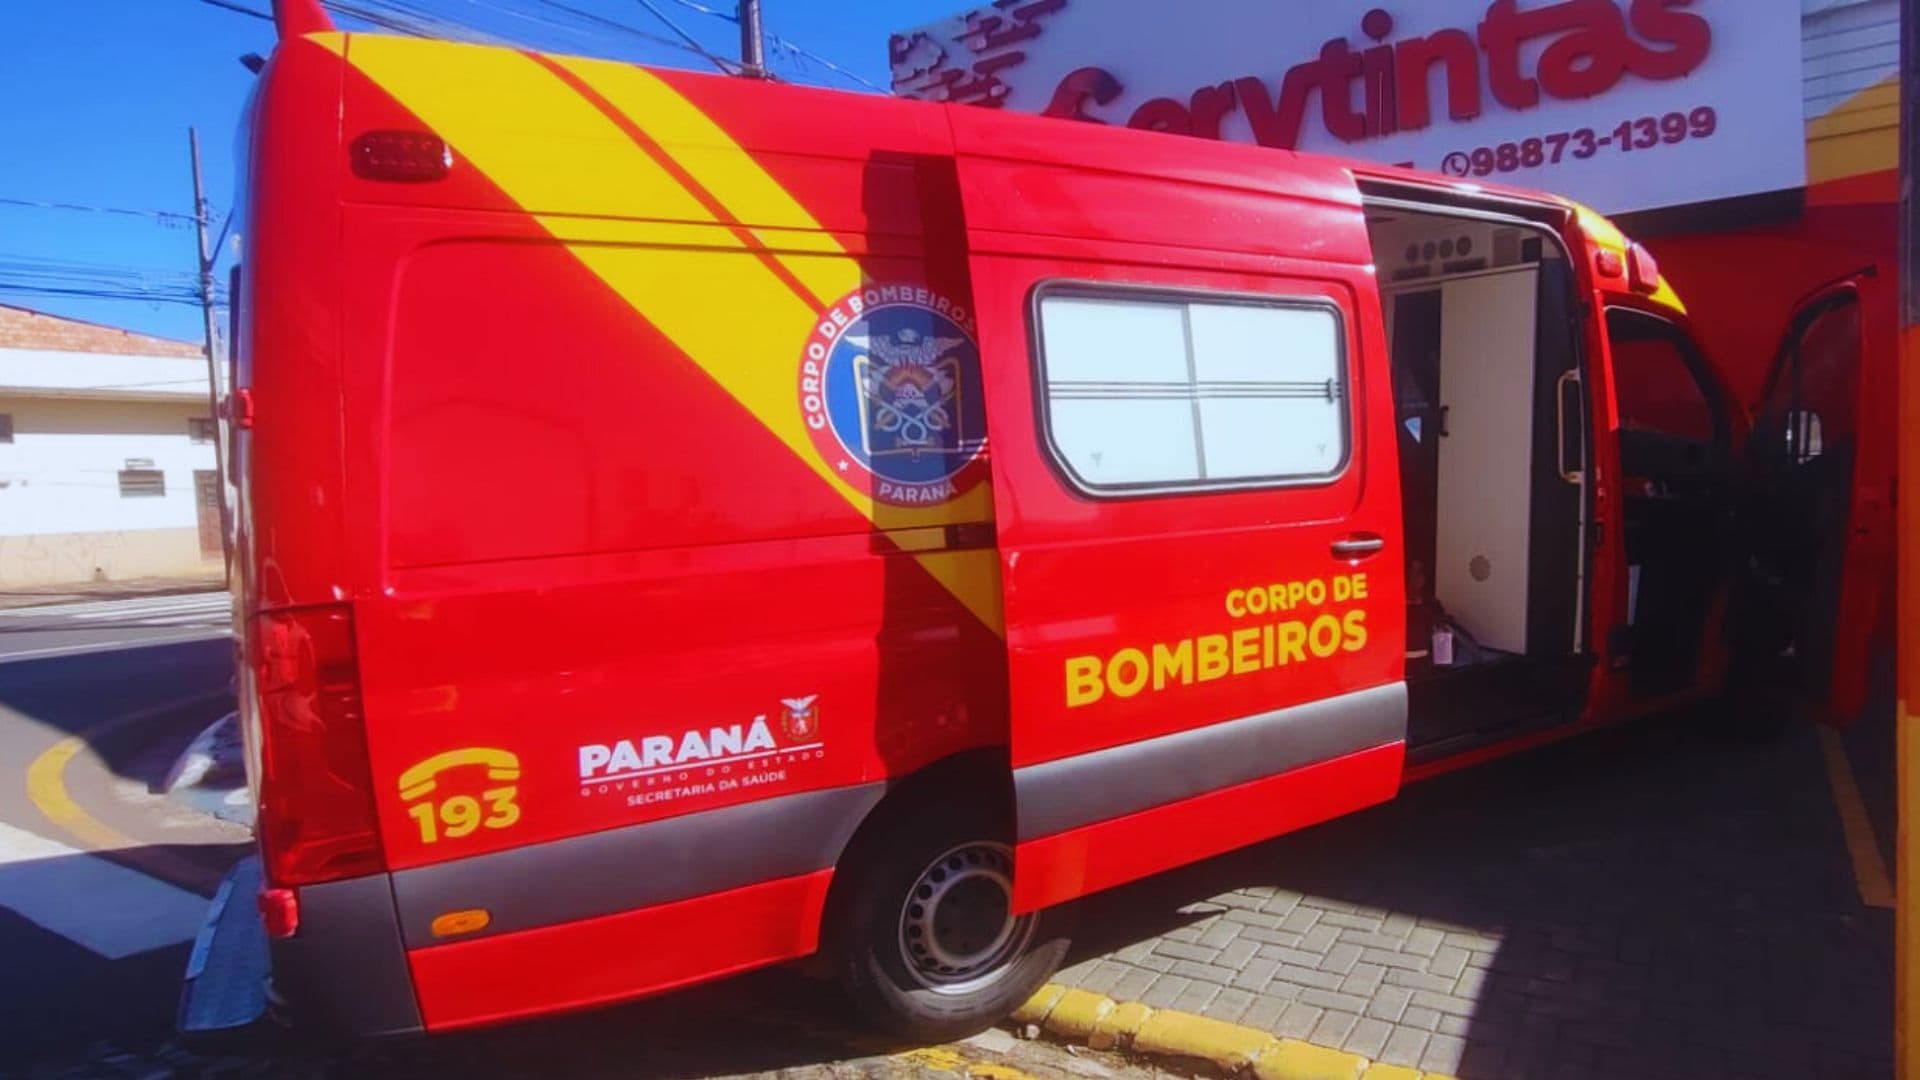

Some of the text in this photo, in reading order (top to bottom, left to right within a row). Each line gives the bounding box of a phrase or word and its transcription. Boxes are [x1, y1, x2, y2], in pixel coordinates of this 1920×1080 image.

[1470, 106, 1717, 177] 98873-1399
[802, 342, 826, 430] CORPO
[818, 307, 849, 339] DE
[1225, 573, 1368, 618] CORPO DE
[1065, 609, 1368, 708] BOMBEIROS
[579, 715, 776, 777] PARANÁ
[581, 749, 825, 797] GOVERNO DO ESTADO
[409, 786, 522, 843] 193
[626, 770, 787, 807] SECRETARIA DA SAÚDE
